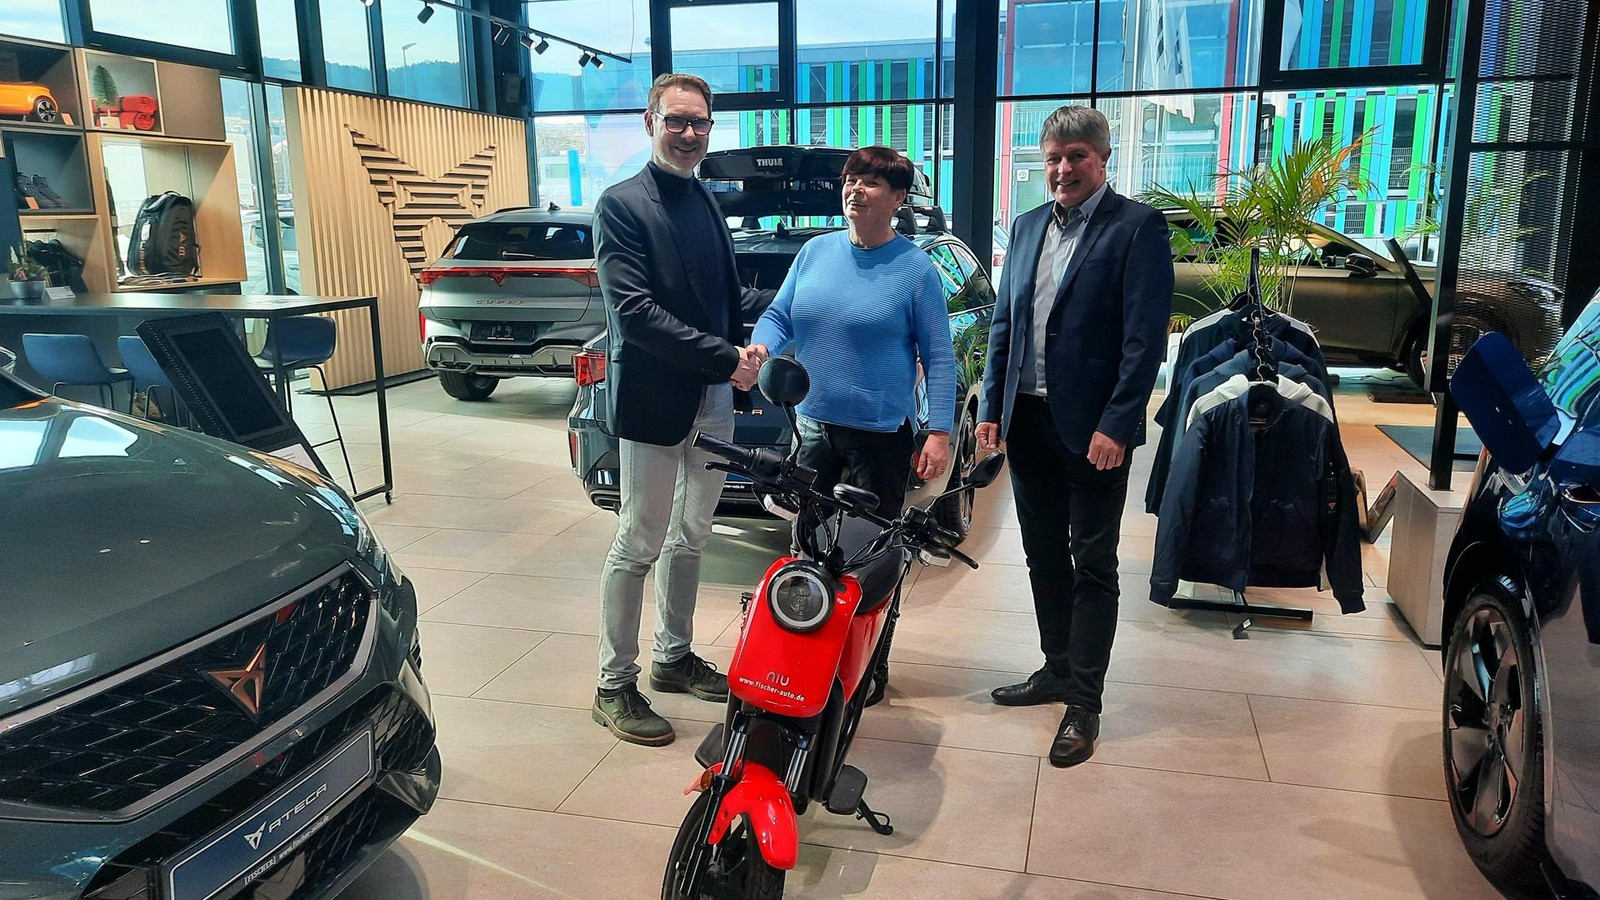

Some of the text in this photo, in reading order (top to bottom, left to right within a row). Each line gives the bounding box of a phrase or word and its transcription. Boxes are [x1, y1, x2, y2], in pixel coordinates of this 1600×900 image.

[756, 158, 783, 167] THULE
[739, 676, 805, 702] www.fischer-auto.de
[268, 783, 327, 834] ATECA
